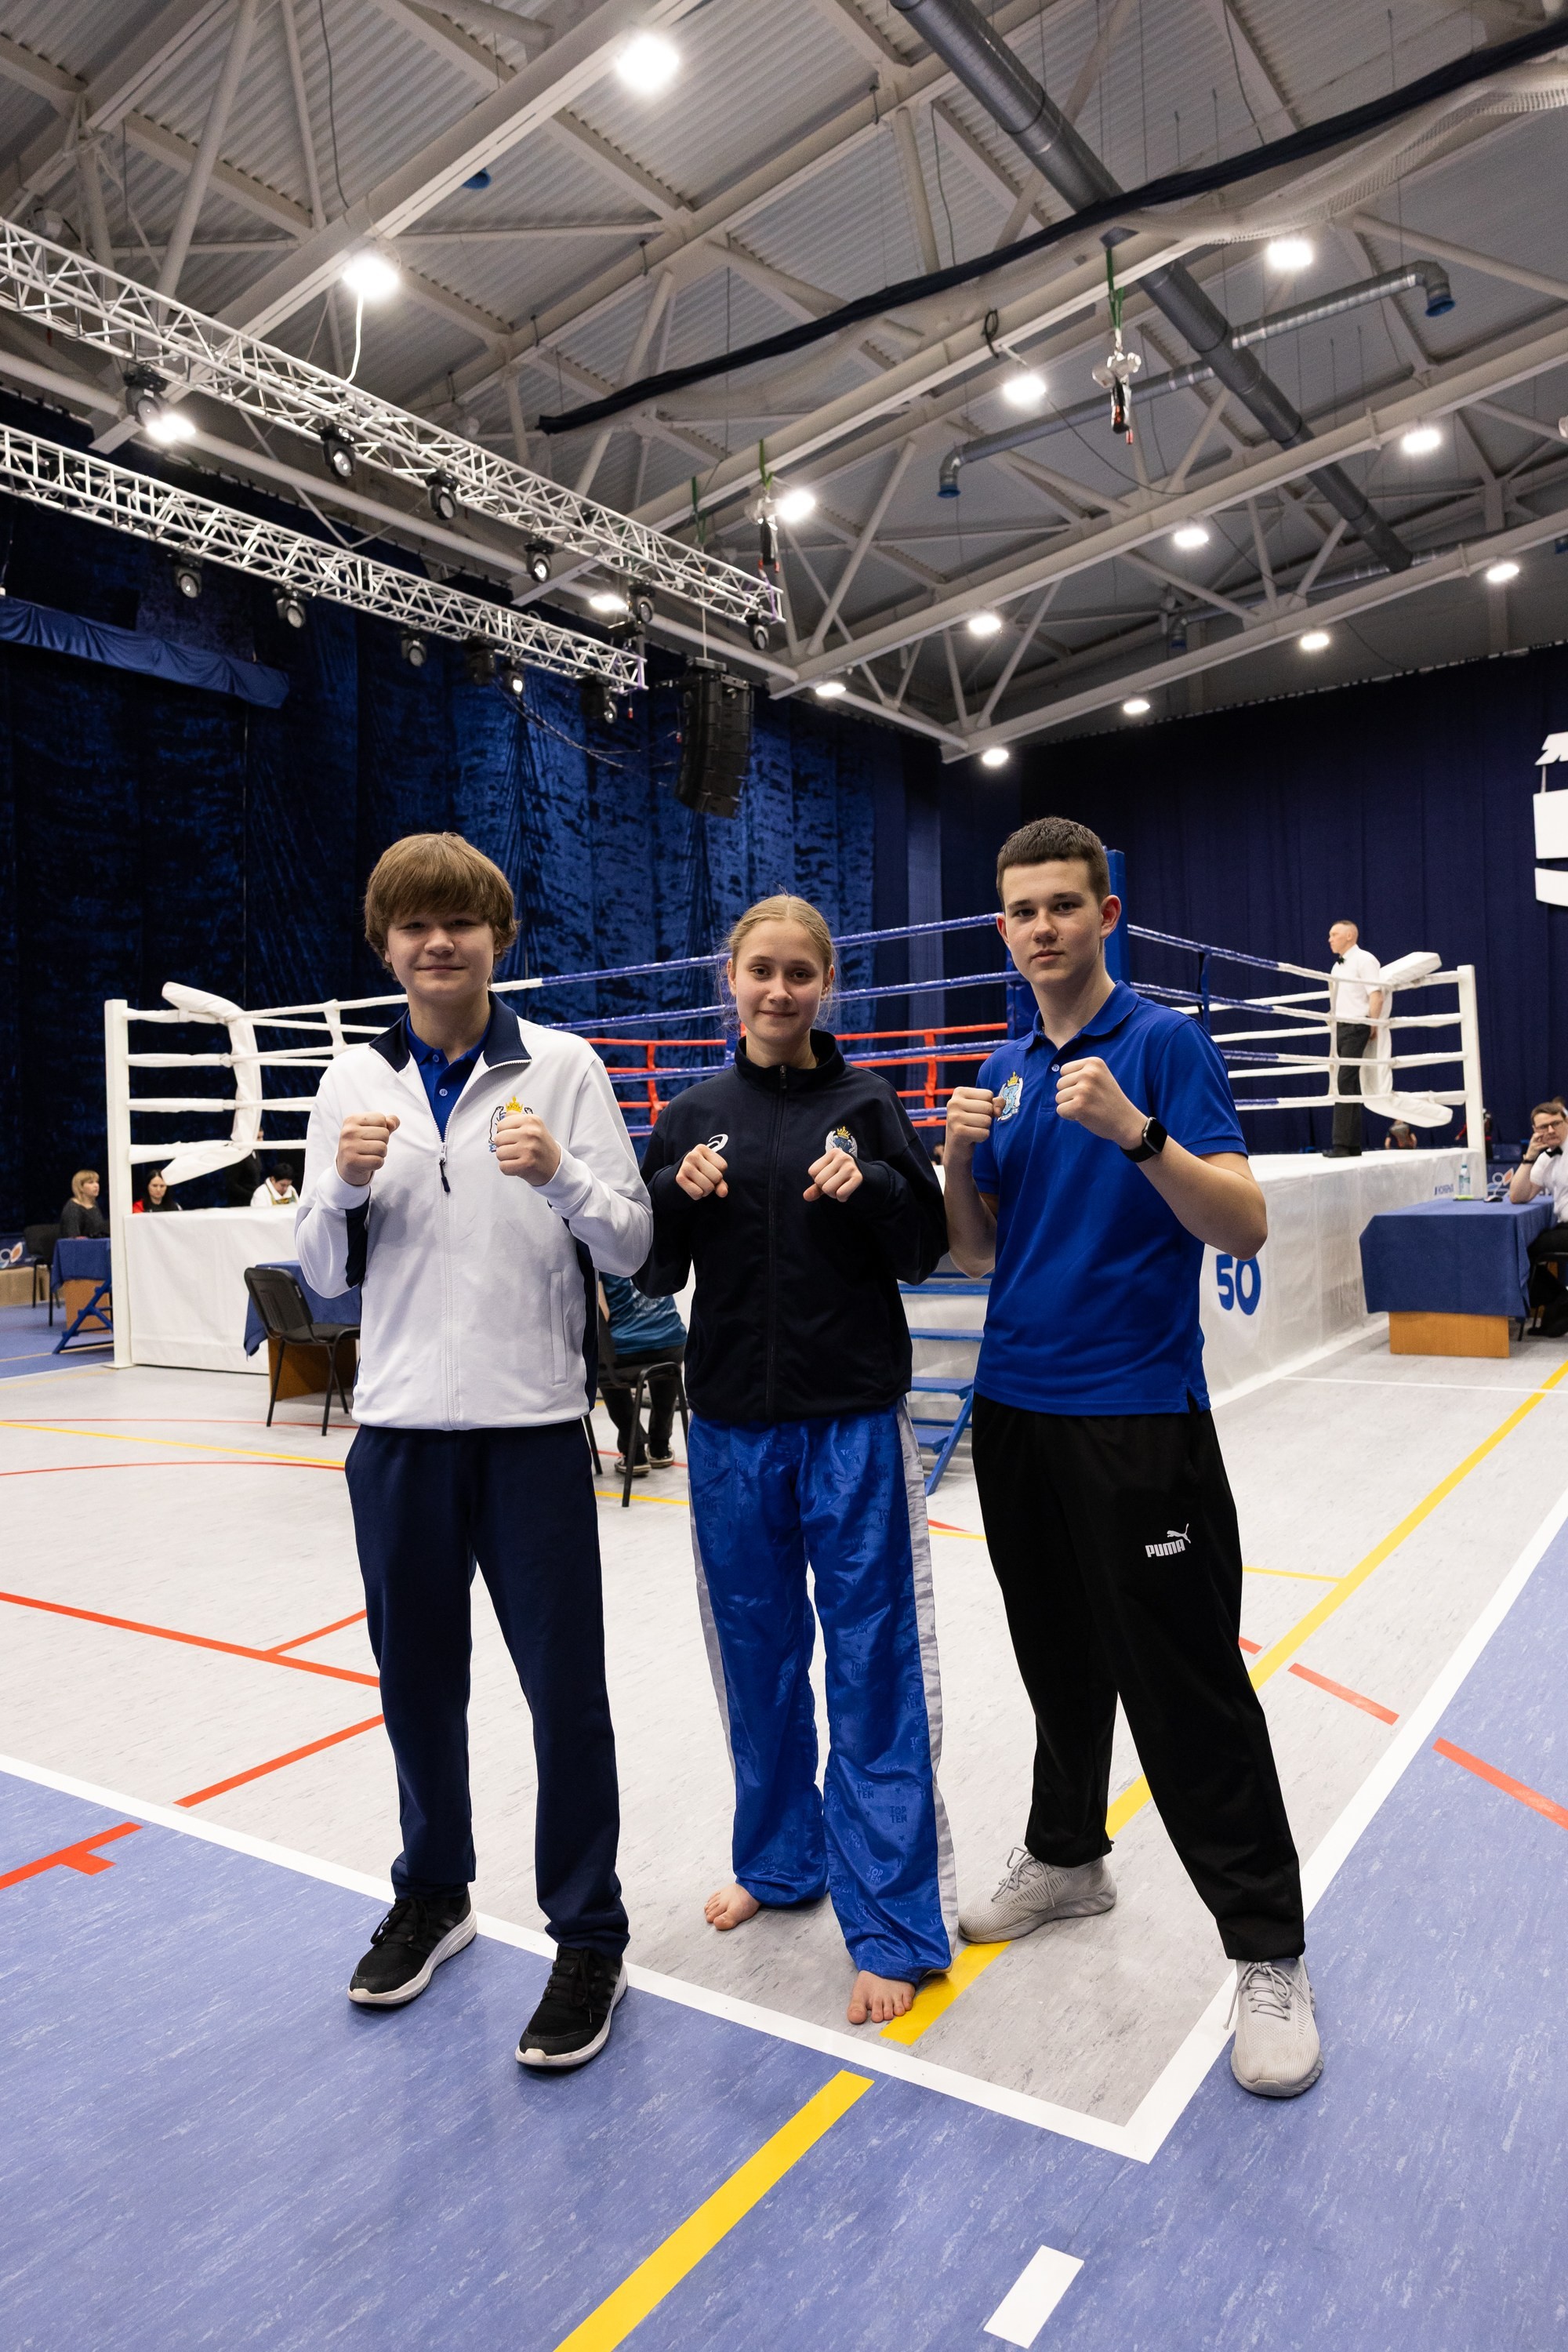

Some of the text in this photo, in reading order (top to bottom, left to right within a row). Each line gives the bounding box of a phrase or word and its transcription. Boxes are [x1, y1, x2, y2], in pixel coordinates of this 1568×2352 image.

[1217, 1254, 1261, 1315] 50
[1145, 1539, 1185, 1557] PUMA
[905, 1700, 921, 1709] TEN
[857, 1781, 873, 1790] TOP
[856, 1790, 874, 1799] TEN
[890, 1806, 906, 1814] TOP
[890, 1814, 908, 1824] TEN
[869, 1865, 883, 1877] TOP
[866, 1872, 881, 1882] TEN
